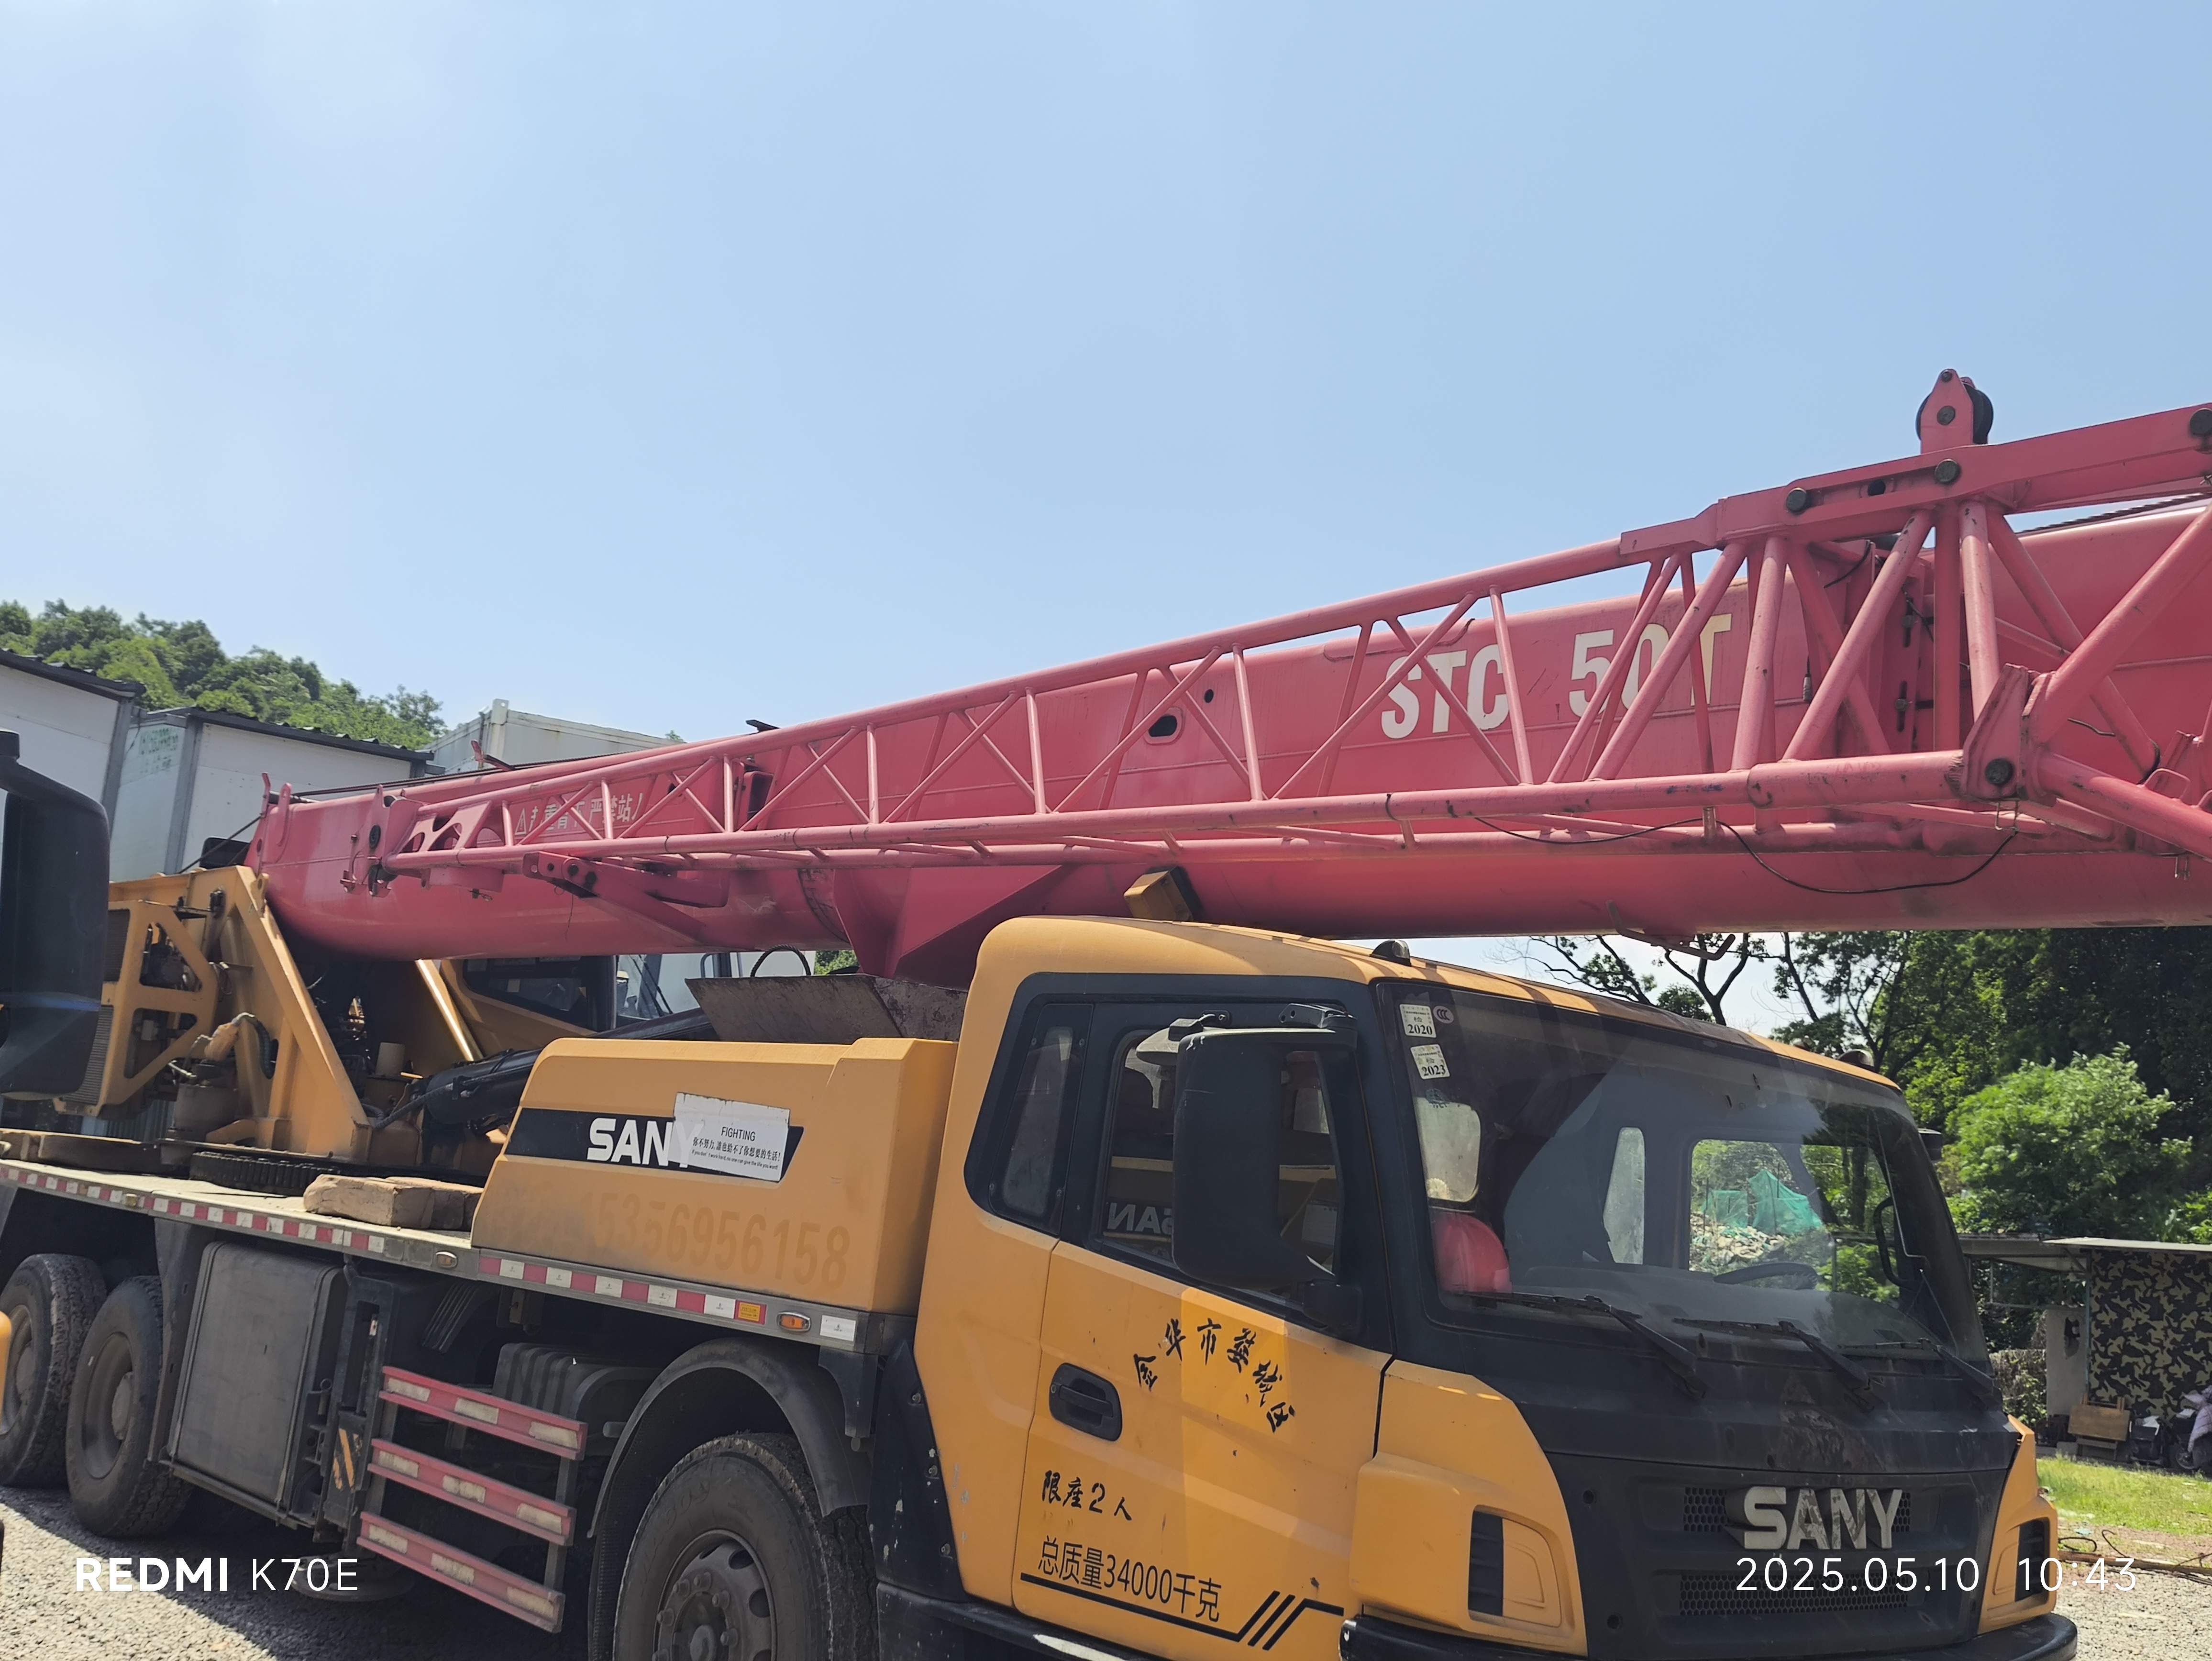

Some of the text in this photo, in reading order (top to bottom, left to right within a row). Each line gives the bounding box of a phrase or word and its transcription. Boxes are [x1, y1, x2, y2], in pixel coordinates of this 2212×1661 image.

[1381, 644, 1510, 740] STC
[1407, 1024, 1433, 1035] 2020
[1422, 1064, 1446, 1076] 2023
[721, 1126, 756, 1141] FIGHTING
[1743, 1486, 1903, 1550] SANY
[1038, 1536, 1222, 1623] 总质量34000千克
